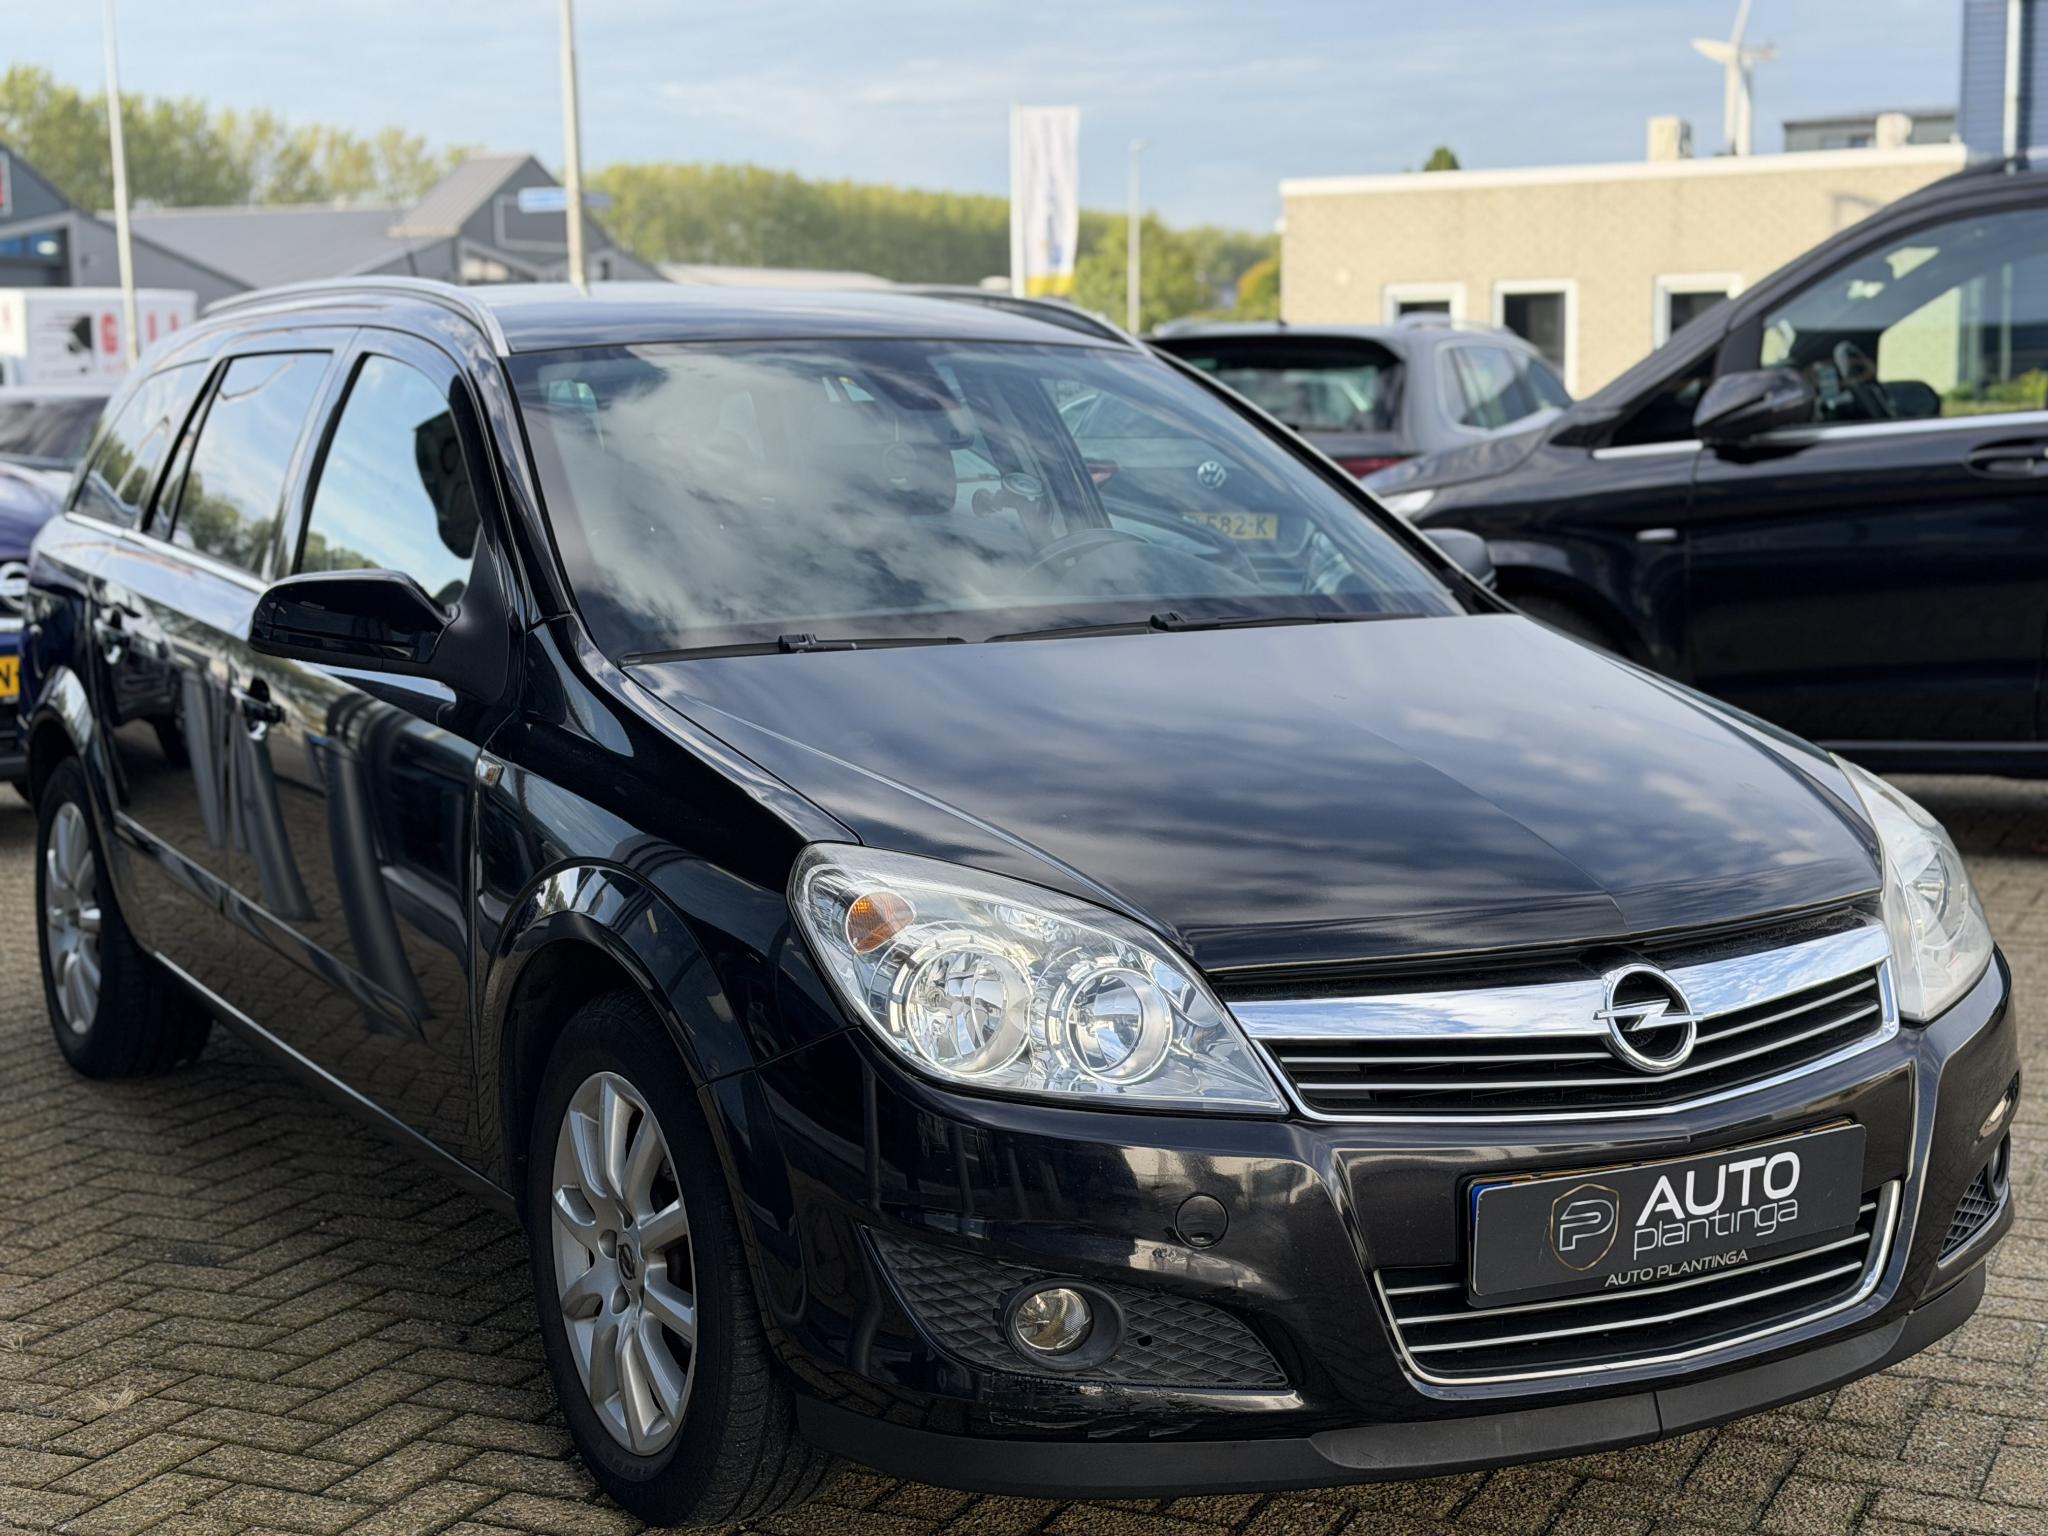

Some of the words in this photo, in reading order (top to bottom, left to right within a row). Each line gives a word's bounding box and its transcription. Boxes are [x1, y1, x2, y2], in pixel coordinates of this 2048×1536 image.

[1635, 1151, 1800, 1226] AUTO
[1633, 1198, 1798, 1261] plantinga
[1604, 1267, 1653, 1287] AUTO
[1656, 1248, 1749, 1279] PLANTINGA
